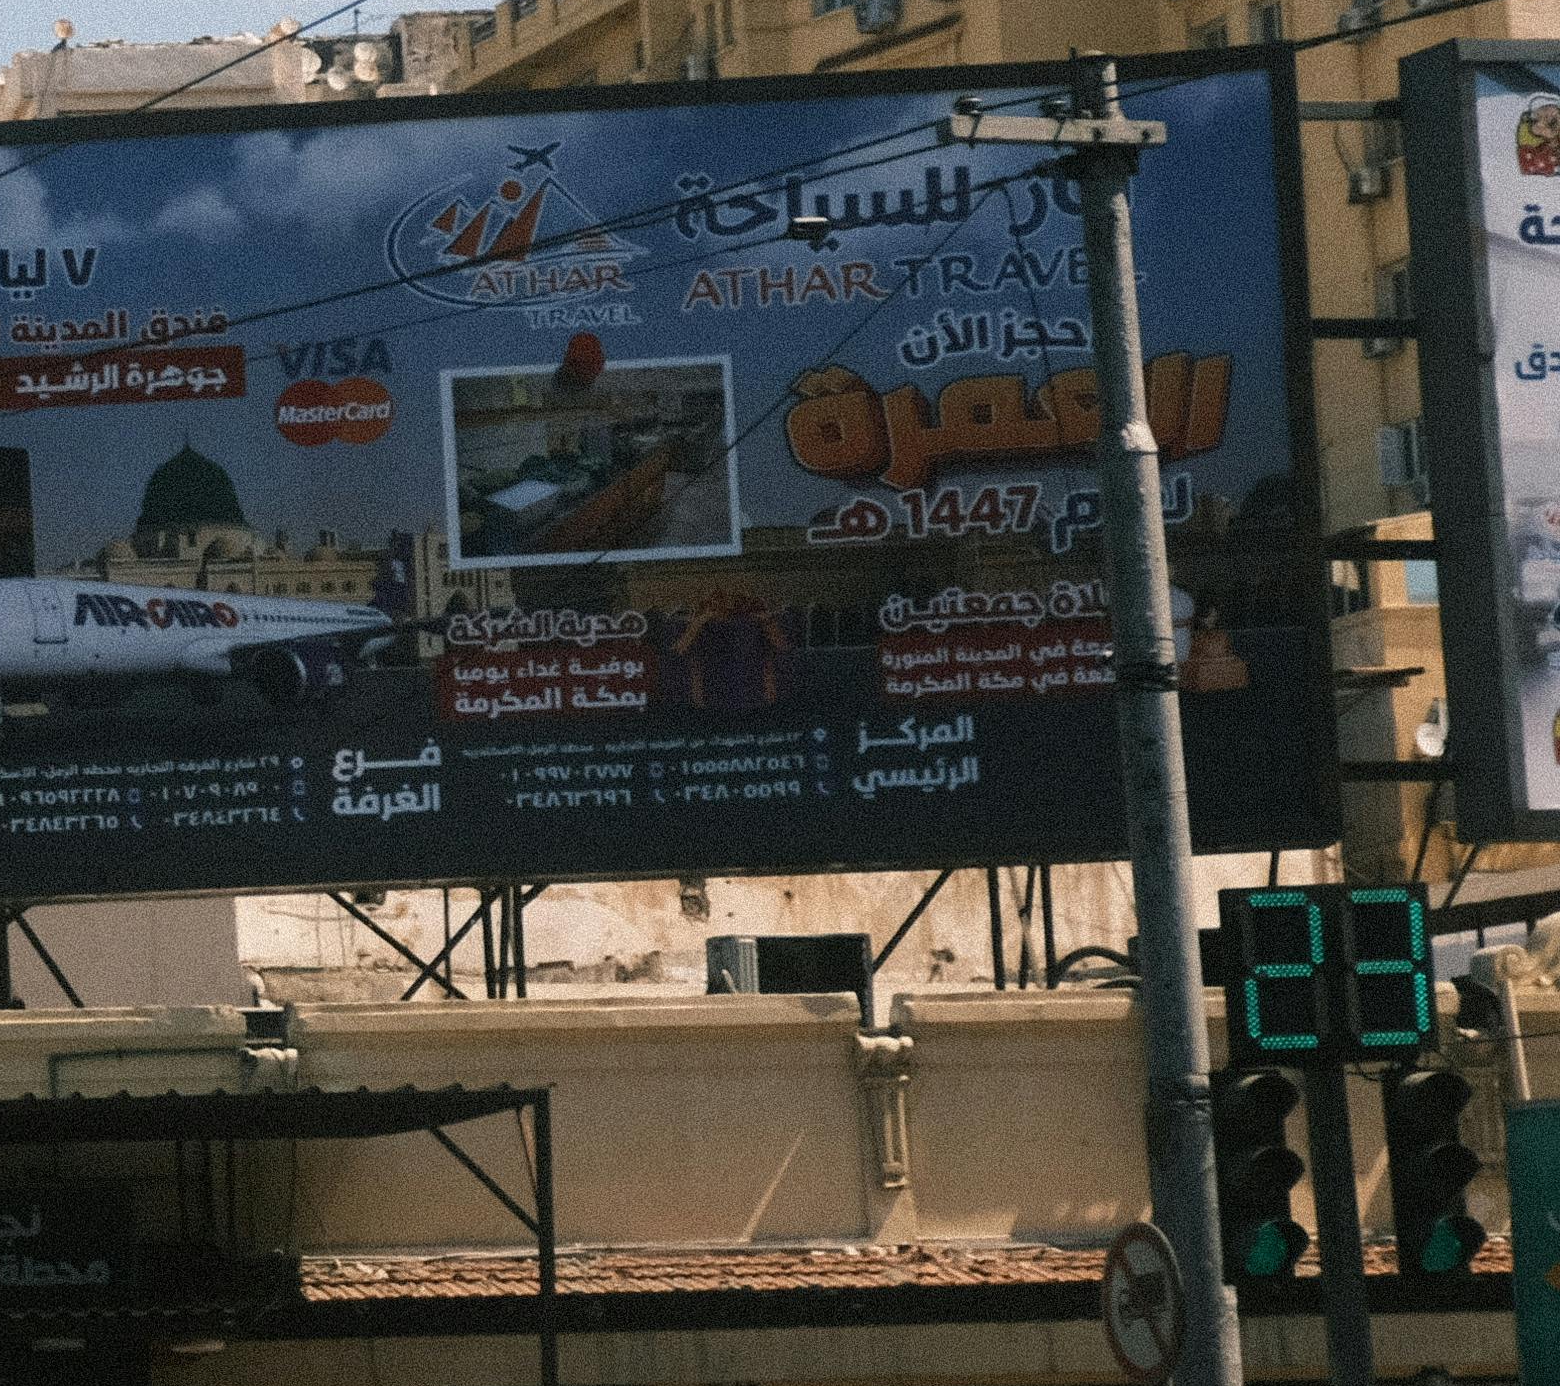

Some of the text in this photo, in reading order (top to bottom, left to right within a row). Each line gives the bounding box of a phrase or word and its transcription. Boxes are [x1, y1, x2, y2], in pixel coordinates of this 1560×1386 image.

[470, 264, 628, 301] ATHAR
[682, 245, 1142, 315] ATHAR TRAVE
[10, 311, 128, 349] المدينة
[138, 309, 230, 346] فندق
[526, 305, 642, 328] TRAVEL
[277, 337, 392, 379] VISA
[277, 401, 391, 424] MasterCard
[900, 485, 1042, 539] 1447
[453, 689, 563, 721] المكرمة
[858, 716, 976, 749] المركز
[852, 757, 980, 797] الرئيسي
[332, 781, 442, 819] الغرفة
[1242, 887, 1432, 1053] 23
[0, 1257, 112, 1289] محطة
